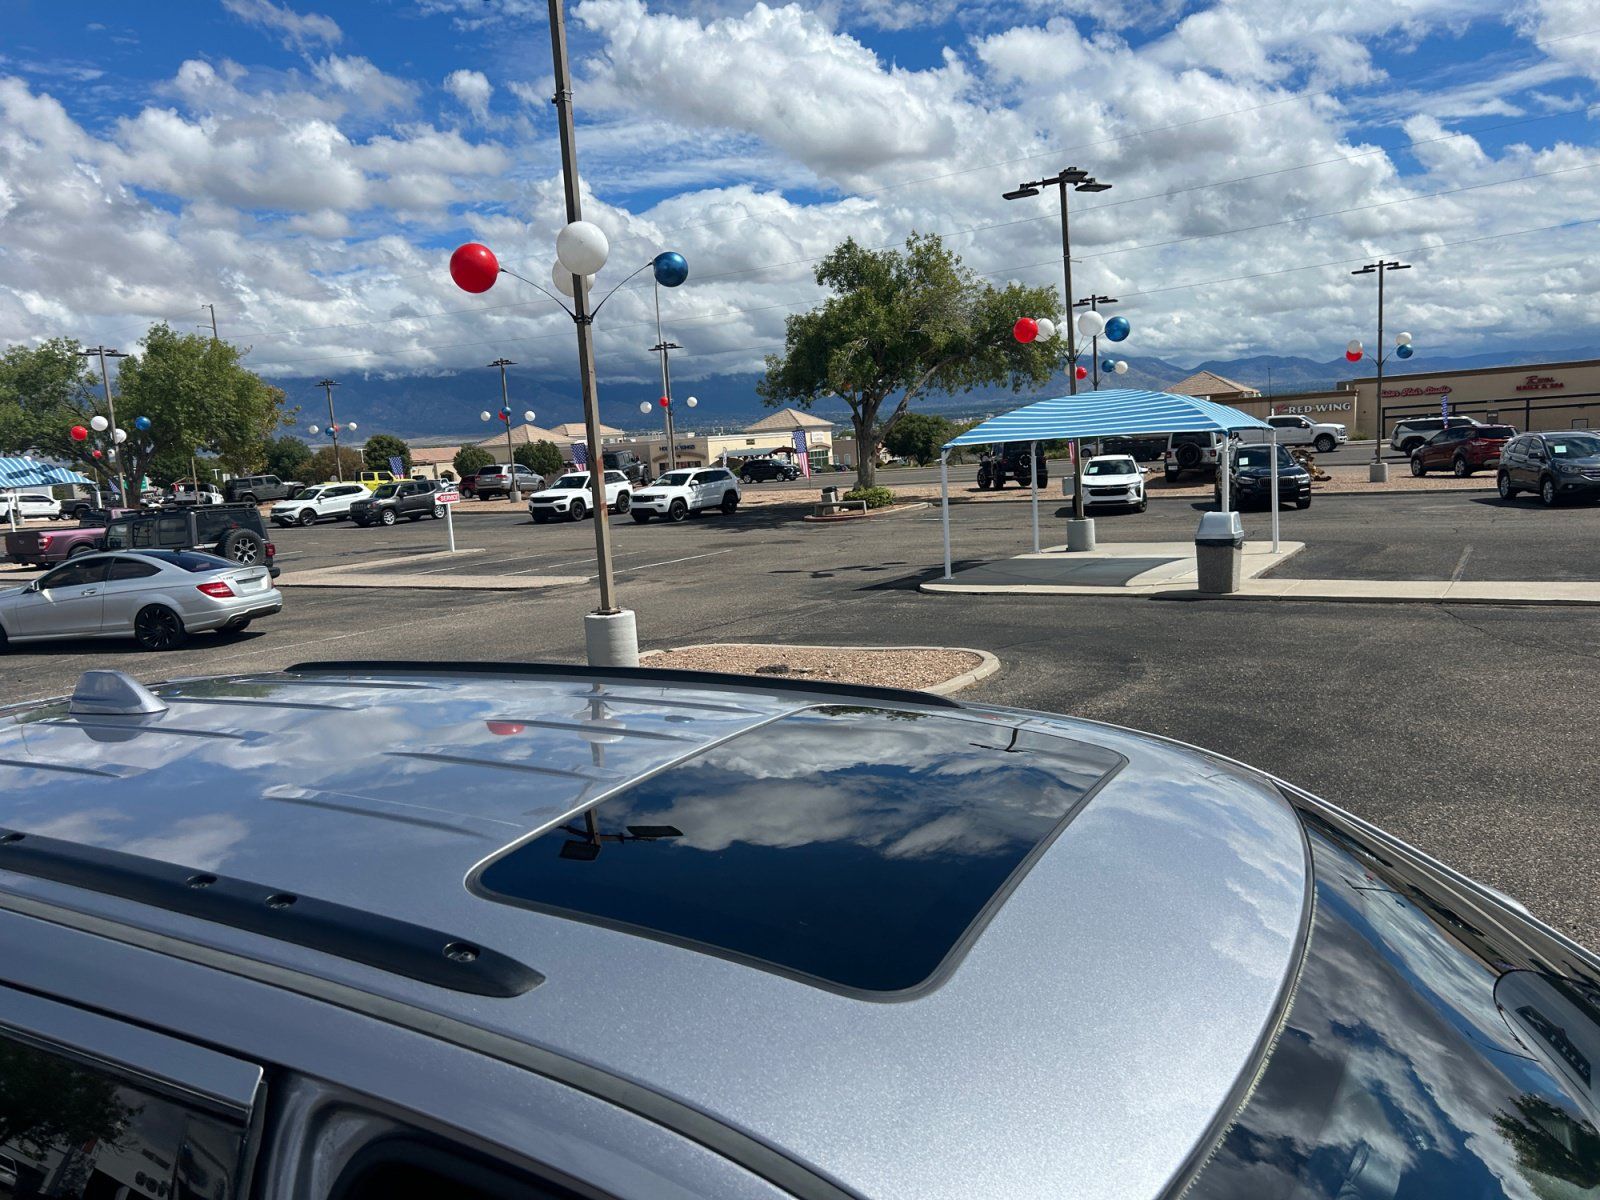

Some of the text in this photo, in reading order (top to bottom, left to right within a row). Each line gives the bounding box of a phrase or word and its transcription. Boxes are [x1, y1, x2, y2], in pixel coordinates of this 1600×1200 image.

[1288, 402, 1351, 414] RED WING
[440, 493, 459, 502] SERVICE
